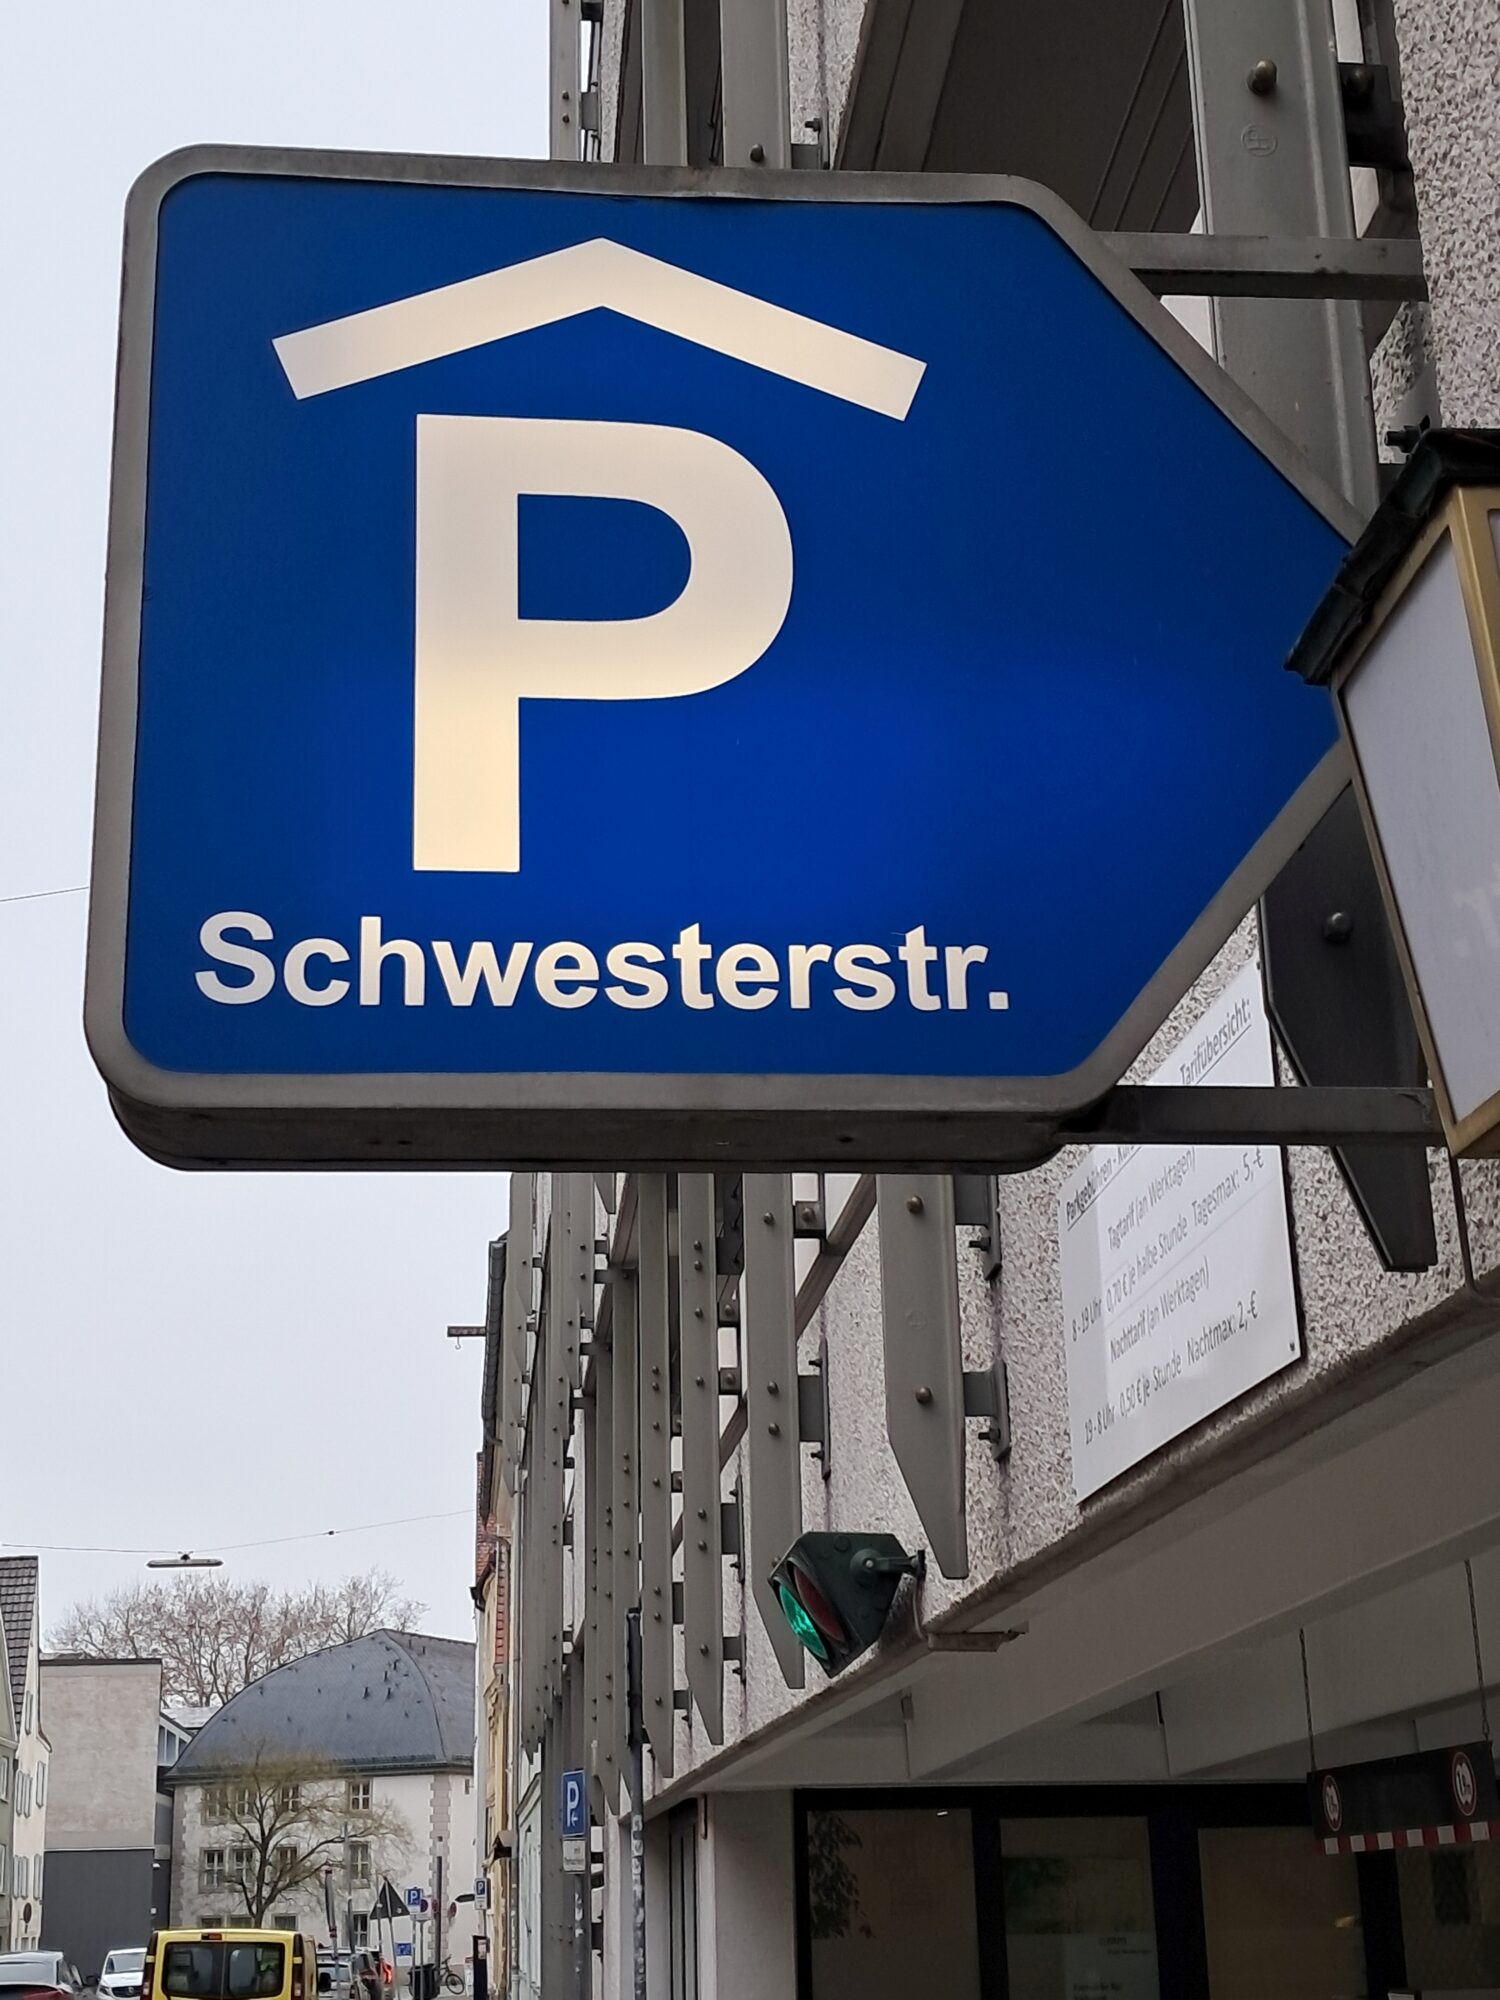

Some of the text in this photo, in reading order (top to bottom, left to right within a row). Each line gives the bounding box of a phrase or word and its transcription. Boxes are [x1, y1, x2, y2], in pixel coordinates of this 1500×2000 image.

[413, 413, 794, 873] P
[195, 911, 1009, 1011] Schwesterstr.
[1180, 998, 1251, 1085] Tarifübersicht:
[1148, 1146, 1195, 1207] Werktagen)
[1158, 1213, 1188, 1259] Stunde
[1191, 1168, 1240, 1227] Tagesmax:
[1160, 1255, 1209, 1319] Werktagen)
[1152, 1349, 1182, 1392] Stunde
[1186, 1314, 1236, 1367] Nachtmax:
[567, 1781, 580, 1828] P
[410, 1890, 418, 1905] P
